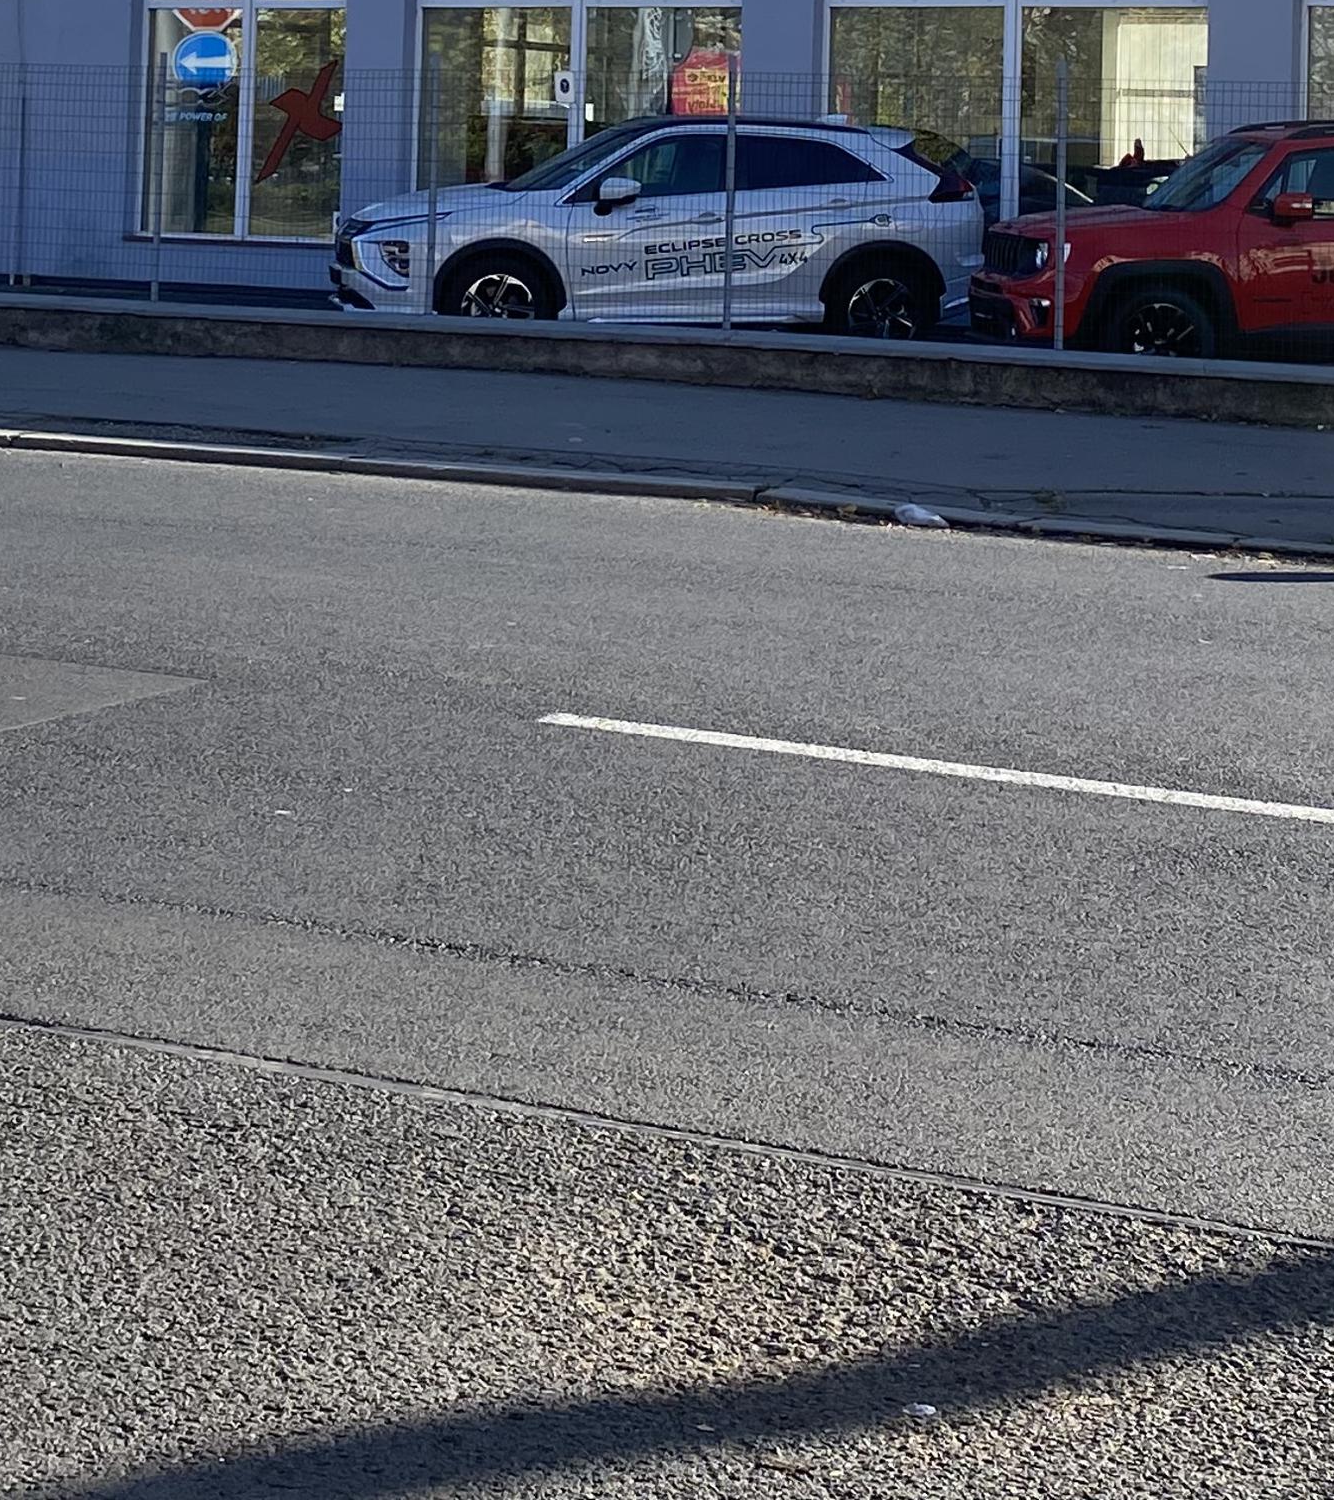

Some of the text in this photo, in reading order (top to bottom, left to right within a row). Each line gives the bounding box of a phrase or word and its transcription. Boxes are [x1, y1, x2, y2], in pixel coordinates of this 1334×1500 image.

[644, 229, 803, 255] ECLIPSE CROSS
[581, 259, 638, 277] NOVÝ
[645, 249, 777, 280] PHEV
